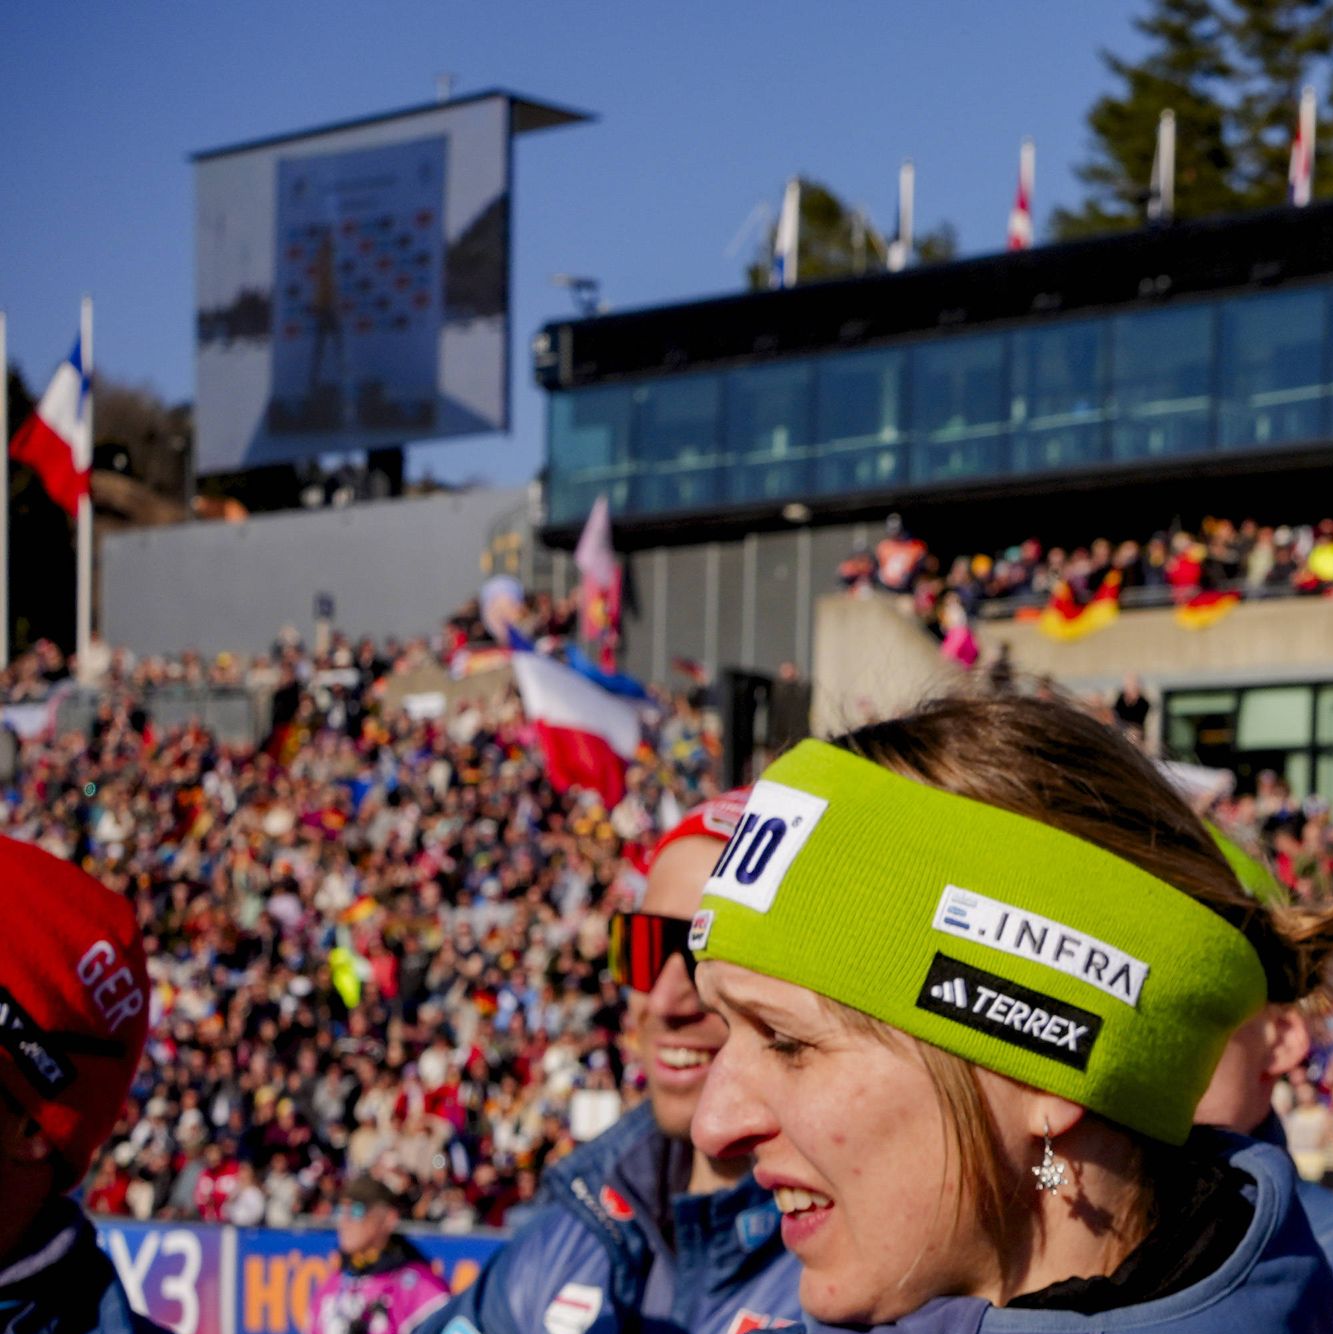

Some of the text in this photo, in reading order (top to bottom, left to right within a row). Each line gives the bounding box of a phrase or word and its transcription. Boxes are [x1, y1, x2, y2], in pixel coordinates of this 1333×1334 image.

[711, 812, 787, 886] ro
[77, 939, 144, 1033] GER
[972, 985, 1089, 1051] TERREX
